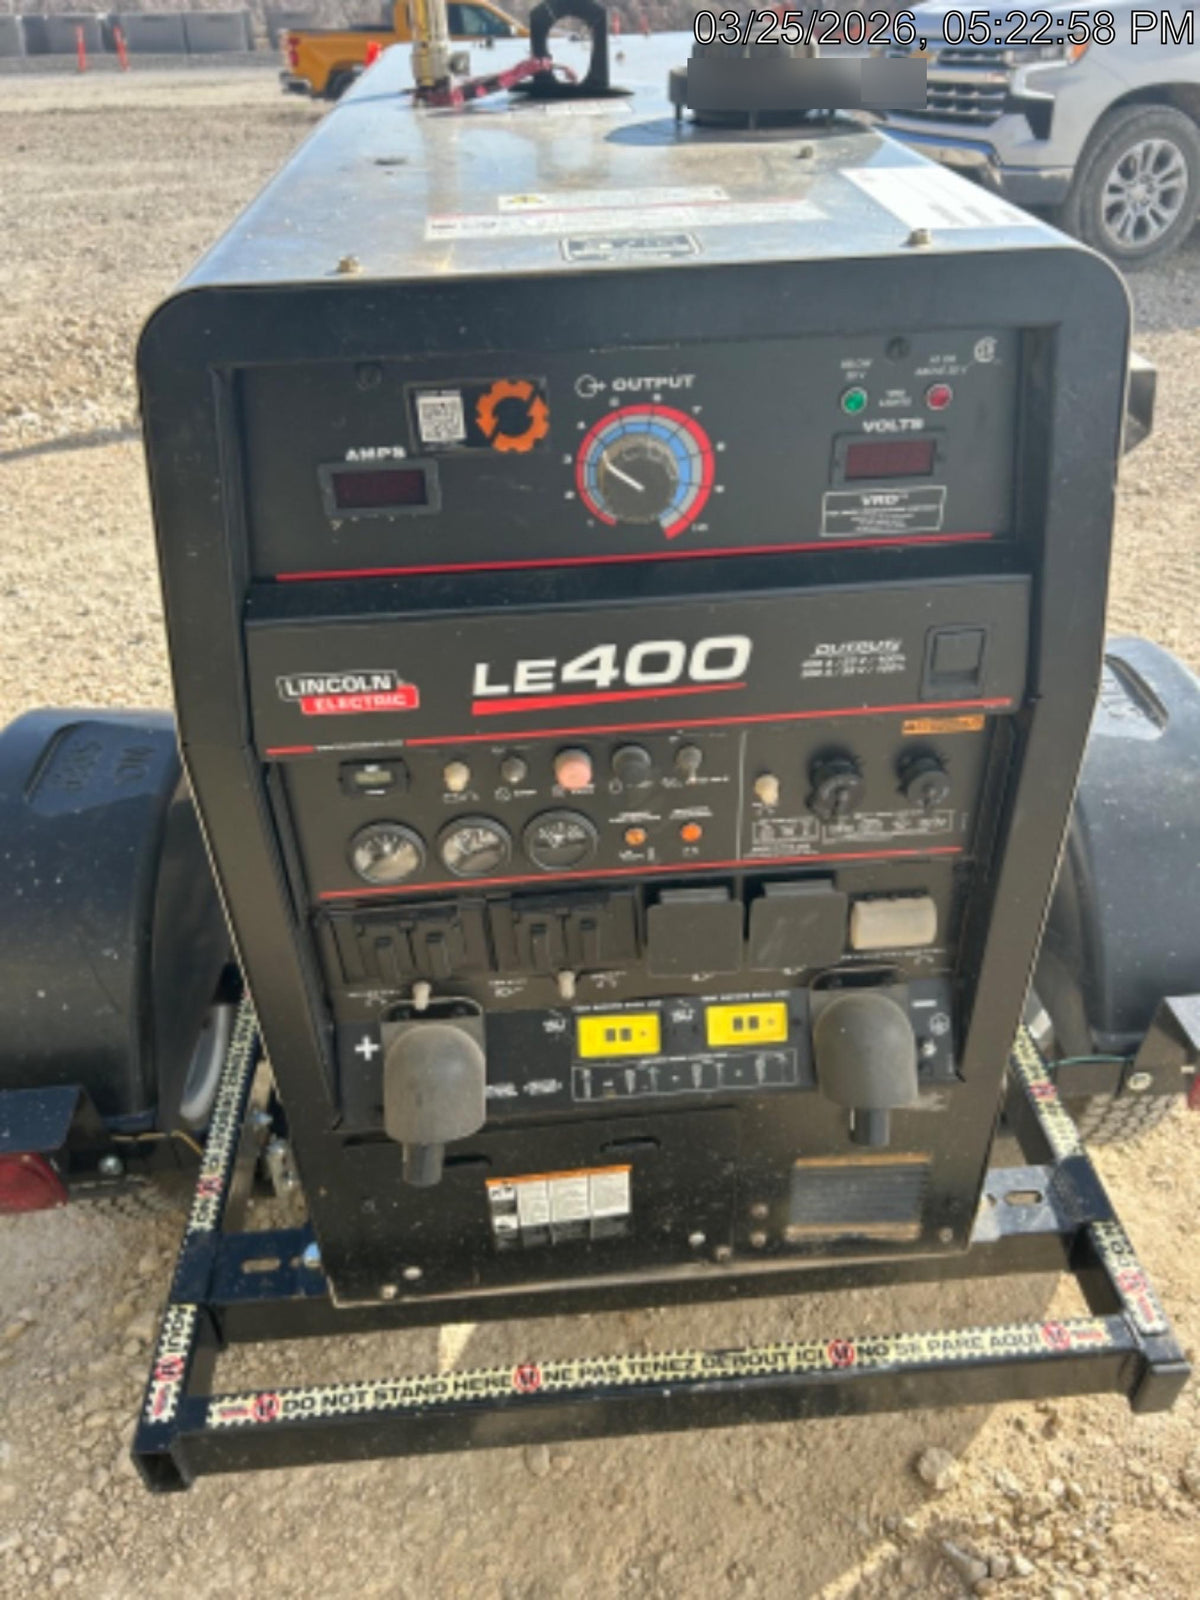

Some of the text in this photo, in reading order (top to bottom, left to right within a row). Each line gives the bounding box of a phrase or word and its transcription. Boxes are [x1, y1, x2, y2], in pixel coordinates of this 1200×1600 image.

[611, 374, 696, 391] OUTPUT
[862, 418, 925, 433] VOLTS
[345, 447, 407, 462] AMPS
[472, 634, 752, 696] LE400
[284, 675, 392, 697] LINCOLN
[313, 694, 408, 711] ELECTRIC
[281, 1396, 315, 1412] DO
[323, 1389, 368, 1407] NOT
[374, 1380, 447, 1402] STAND
[856, 1342, 890, 1357] NO
